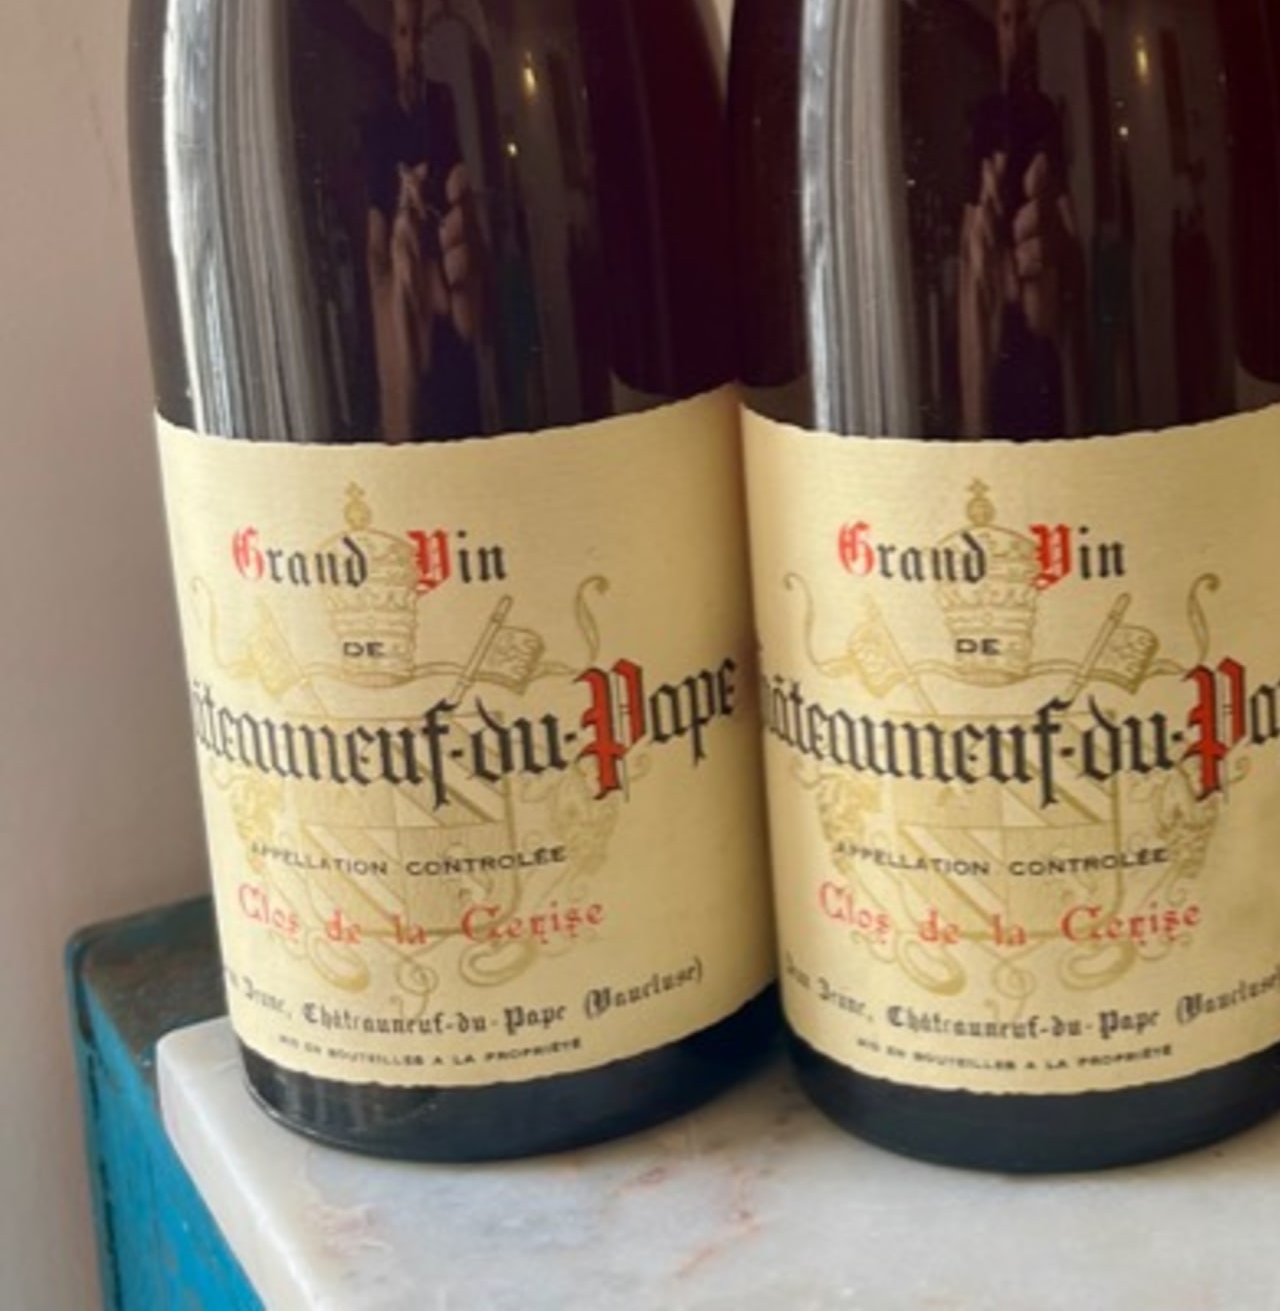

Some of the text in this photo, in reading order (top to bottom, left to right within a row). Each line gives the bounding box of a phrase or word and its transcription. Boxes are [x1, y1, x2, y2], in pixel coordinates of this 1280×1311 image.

[232, 527, 508, 596] Grand Vin
[837, 522, 1126, 589] Grand Vin
[343, 640, 385, 658] DE
[956, 638, 1002, 656] DE
[251, 843, 388, 876] APPELLATION
[834, 843, 990, 876] APPELLATION
[239, 883, 604, 945] Clos de la Cerise
[819, 882, 1200, 946] Clos de la Cerise
[453, 1055, 475, 1065] LA
[1045, 1060, 1068, 1070] LA
